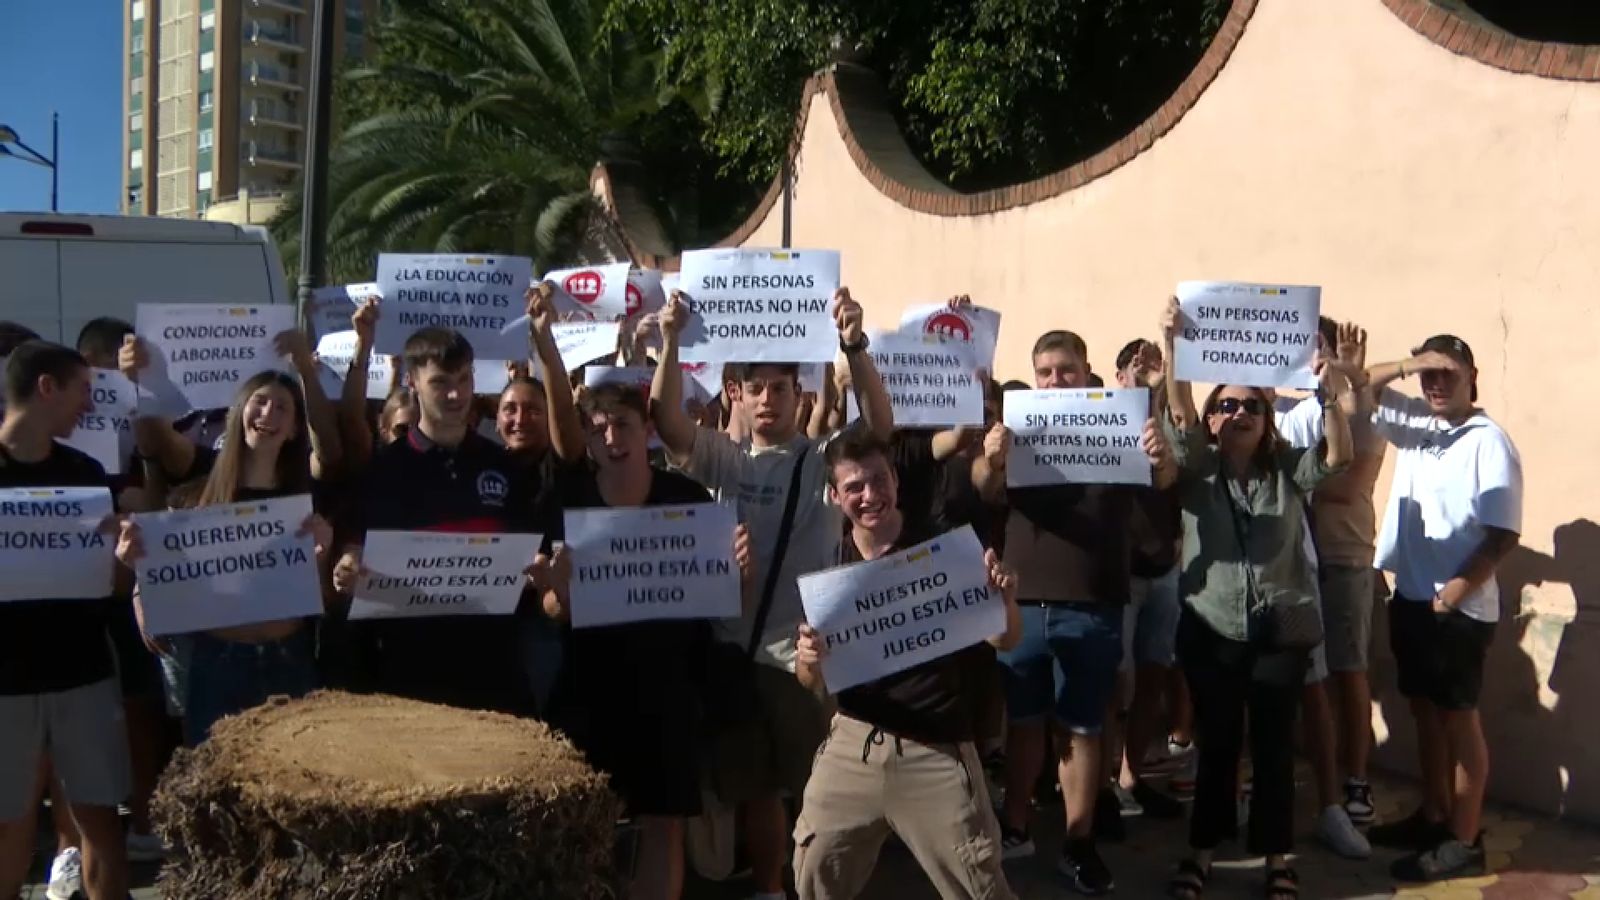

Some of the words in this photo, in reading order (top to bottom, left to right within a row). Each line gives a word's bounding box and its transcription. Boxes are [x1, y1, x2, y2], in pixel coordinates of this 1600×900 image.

[394, 268, 422, 282] ¿LA
[426, 268, 514, 286] EDUCACIÓN
[702, 274, 728, 290] SIN
[732, 274, 814, 289] PERSONAS
[397, 287, 462, 304] PÚBLICA
[465, 292, 489, 306] NO
[492, 294, 510, 308] ES
[689, 299, 764, 314] EXPERTAS
[768, 300, 792, 314] NO
[798, 299, 828, 313] HAY
[1198, 306, 1221, 320] SIN
[1224, 308, 1300, 324] PERSONAS
[399, 312, 506, 329] IMPORTANTE?
[163, 324, 267, 340] CONDICIONES
[710, 321, 806, 338] FORMACIÓN
[1184, 328, 1252, 343] EXPERTAS
[1256, 332, 1278, 344] NO
[1283, 332, 1310, 346] HAY
[171, 347, 256, 362] LABORALES
[892, 353, 961, 368] PERSONAS
[1202, 350, 1290, 366] FORMACIÓN
[183, 370, 240, 386] DIGNAS
[881, 373, 920, 386] ERTAS
[924, 374, 944, 387] NO
[948, 374, 972, 387] HAY
[892, 391, 957, 408] RMACIÓN
[1026, 414, 1048, 427] SIN
[1052, 413, 1128, 426] PERSONAS
[1014, 434, 1082, 448] EXPERTAS
[1086, 436, 1108, 448] NO
[1112, 436, 1140, 448] HAY
[1034, 453, 1121, 466] FORMACIÓN
[2, 501, 83, 518] REMOS
[76, 531, 104, 548] YA
[163, 520, 286, 552] QUEREMOS
[610, 534, 696, 554] NUESTRO
[146, 551, 278, 585] SOLUCIONES
[281, 547, 308, 567] YA
[406, 556, 493, 569] NUESTRO
[579, 562, 652, 583] FUTURO
[659, 556, 701, 577] ESTÁ
[706, 558, 729, 576] EN
[366, 576, 444, 590] FUTURO
[448, 572, 488, 587] ESTÁ
[493, 575, 518, 586] EN
[408, 594, 468, 606] JUEGO
[627, 586, 686, 605] JUEGO
[855, 572, 948, 614] NUESTRO
[826, 612, 906, 649] FUTURO
[912, 592, 958, 621] ESTÁ
[962, 586, 990, 606] EN
[883, 628, 947, 660] JUEGO
